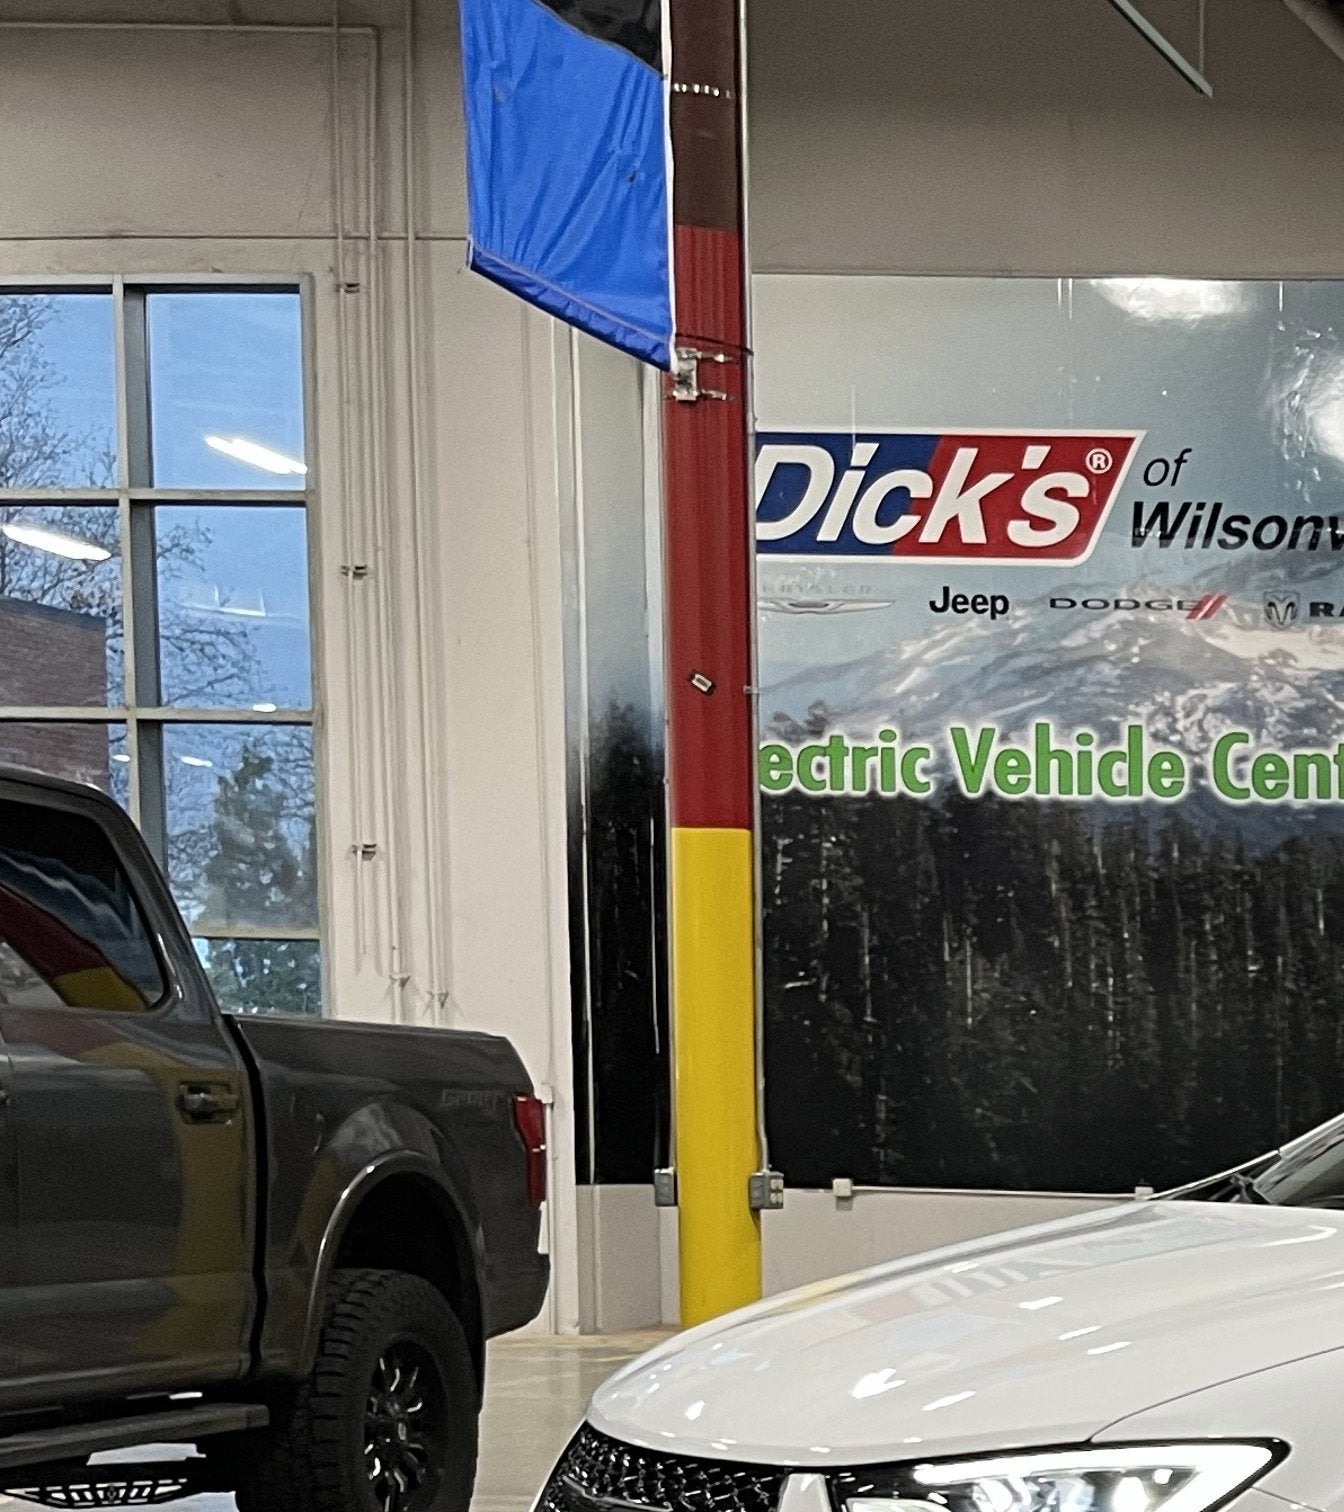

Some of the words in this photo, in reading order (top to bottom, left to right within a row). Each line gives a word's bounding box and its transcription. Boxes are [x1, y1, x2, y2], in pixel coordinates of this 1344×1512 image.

[1142, 449, 1193, 489] of
[929, 586, 1009, 620] Jeep
[1049, 598, 1198, 611] DODGE
[758, 730, 931, 796] ectric
[950, 723, 1187, 799] Vehicle
